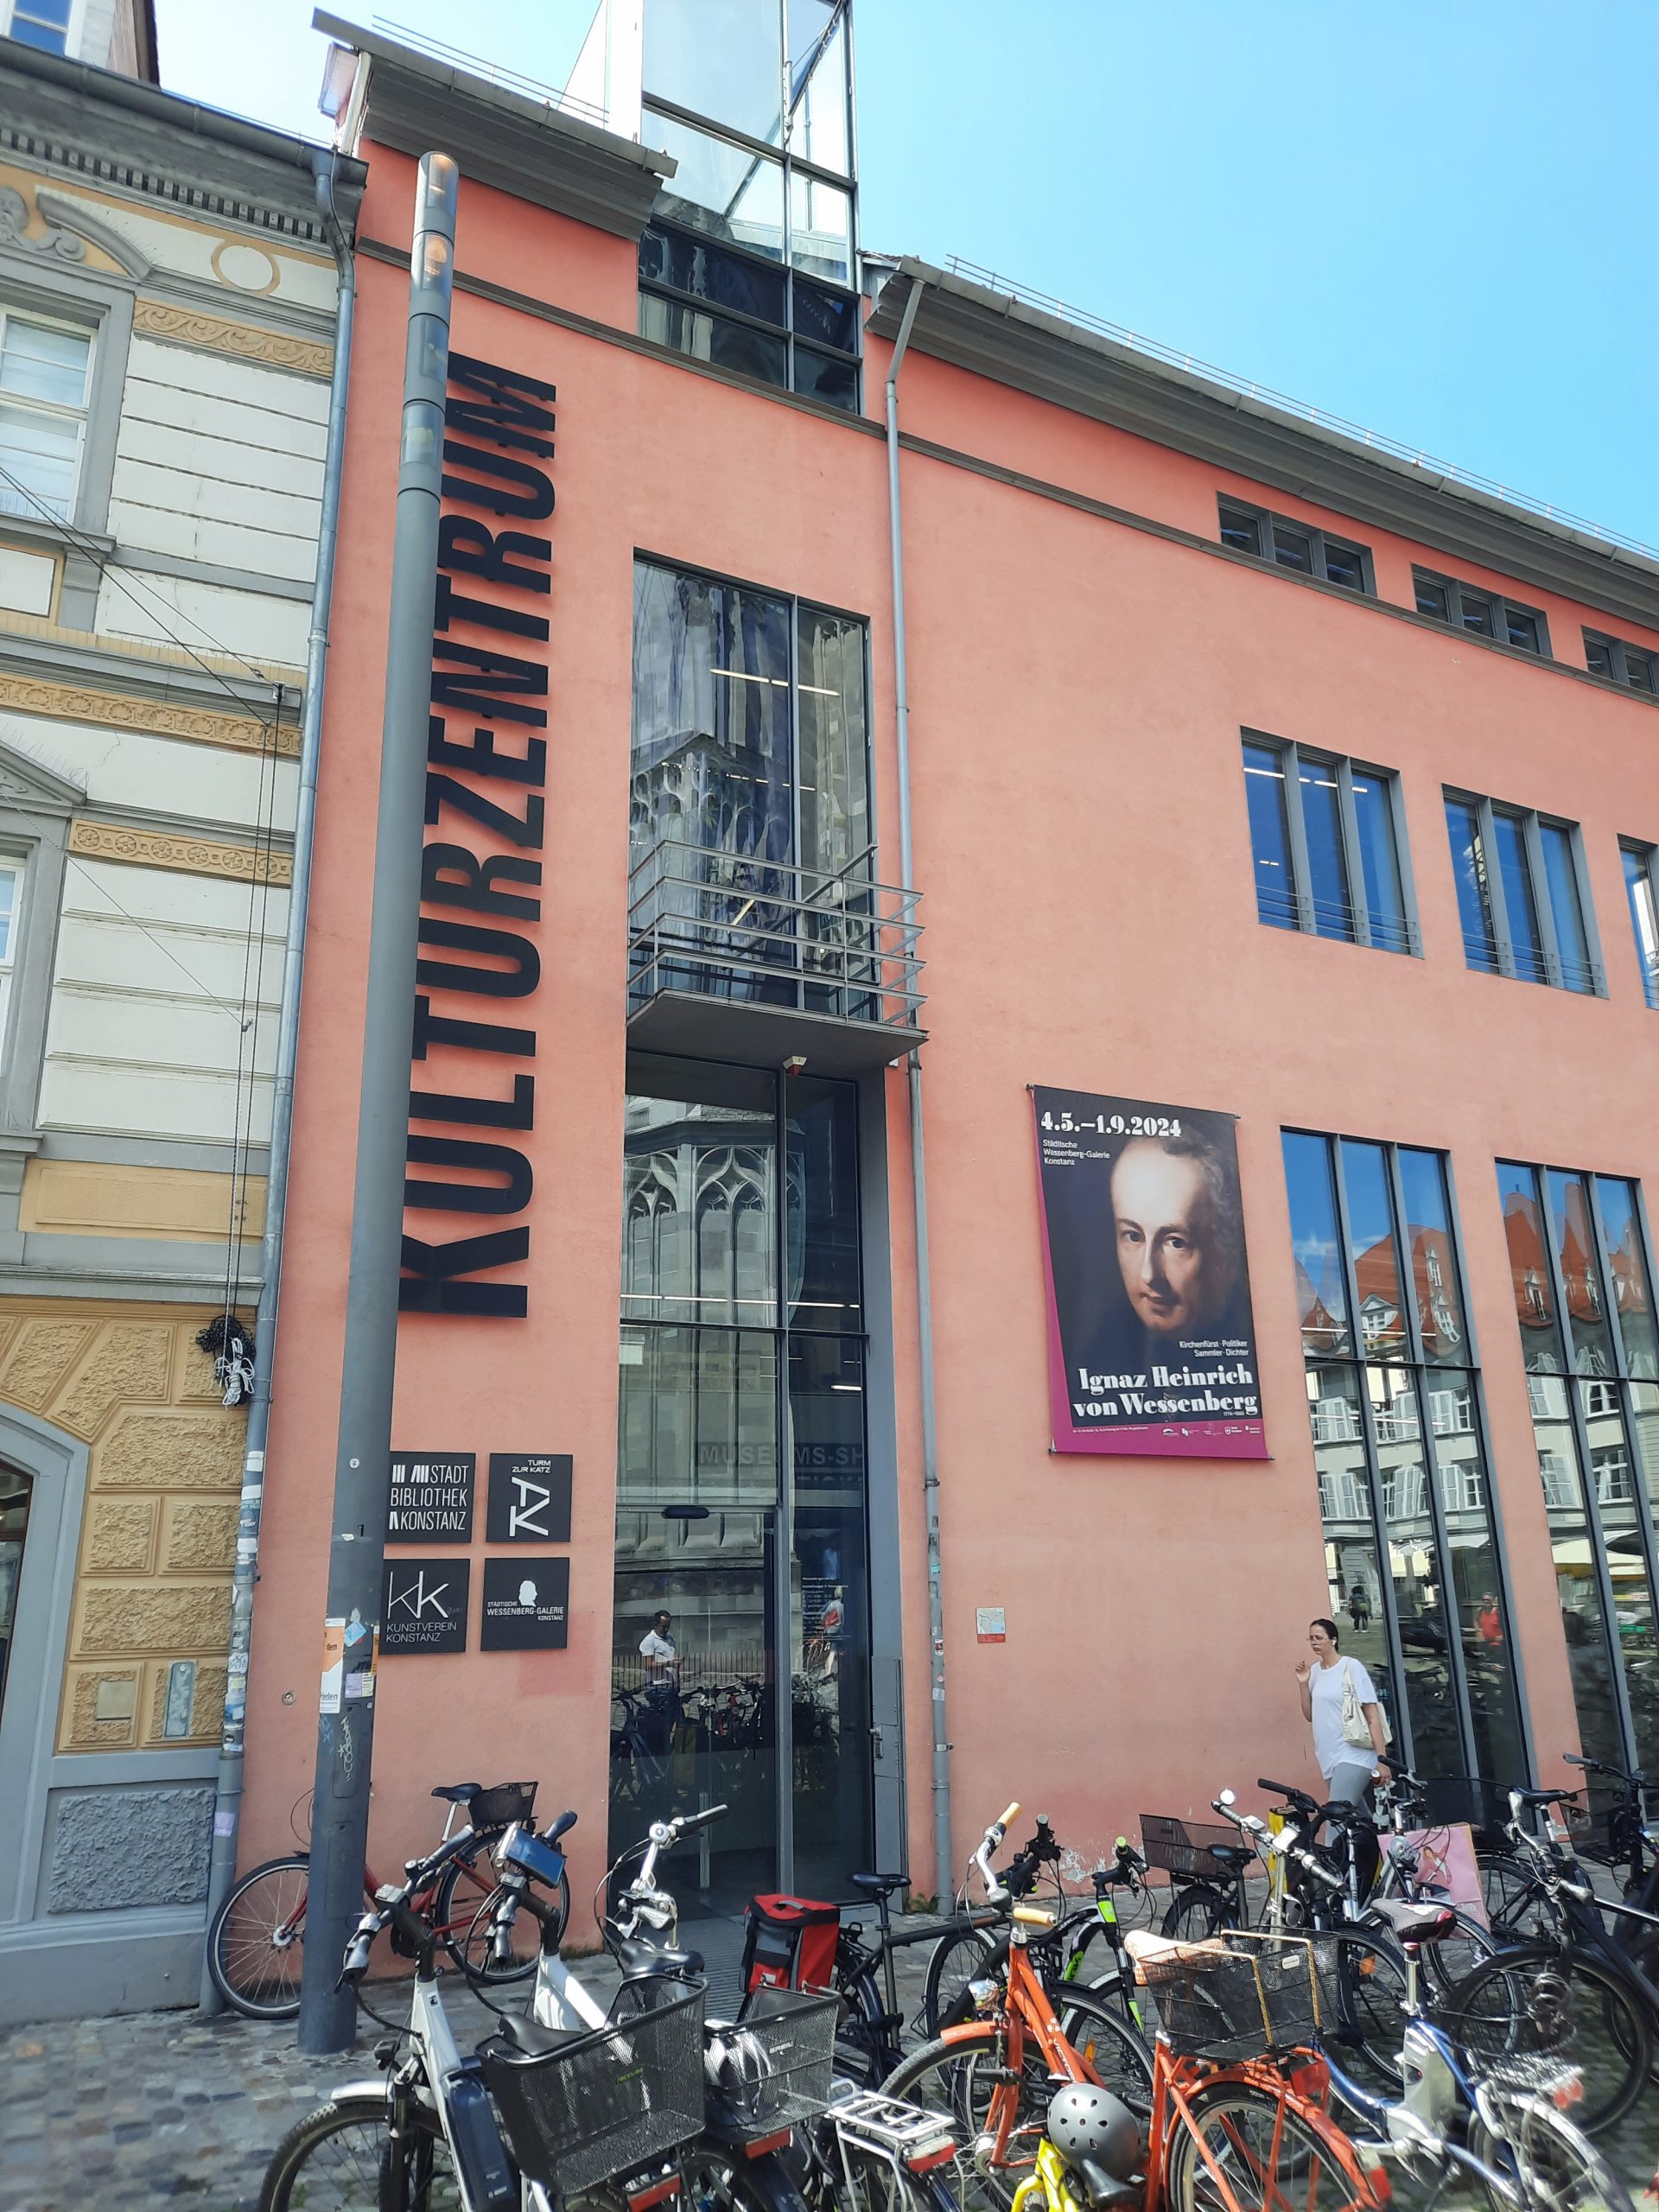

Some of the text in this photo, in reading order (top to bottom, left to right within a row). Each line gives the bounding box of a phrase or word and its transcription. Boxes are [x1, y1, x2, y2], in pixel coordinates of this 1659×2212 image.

[397, 351, 557, 1319] KULTURZENTRUM
[1042, 1139, 1077, 1149] Städtische
[1043, 1148, 1111, 1160] Wessenberg-Galerie
[1044, 1156, 1076, 1166] Konstanz
[1193, 1348, 1249, 1357] Sammler Dichter
[1077, 1363, 1253, 1395] Ignaz Heinrich
[1072, 1389, 1258, 1417] von Wessenberg
[429, 1465, 469, 1484] STADT
[390, 1487, 468, 1507] BIBLIOTHEK
[400, 1510, 467, 1530] KONSTANZ
[486, 1606, 564, 1616] WESSENBERG-GALERIE
[386, 1622, 457, 1633] KUNSTVEREIN
[385, 1632, 442, 1643] KONSTANZ
